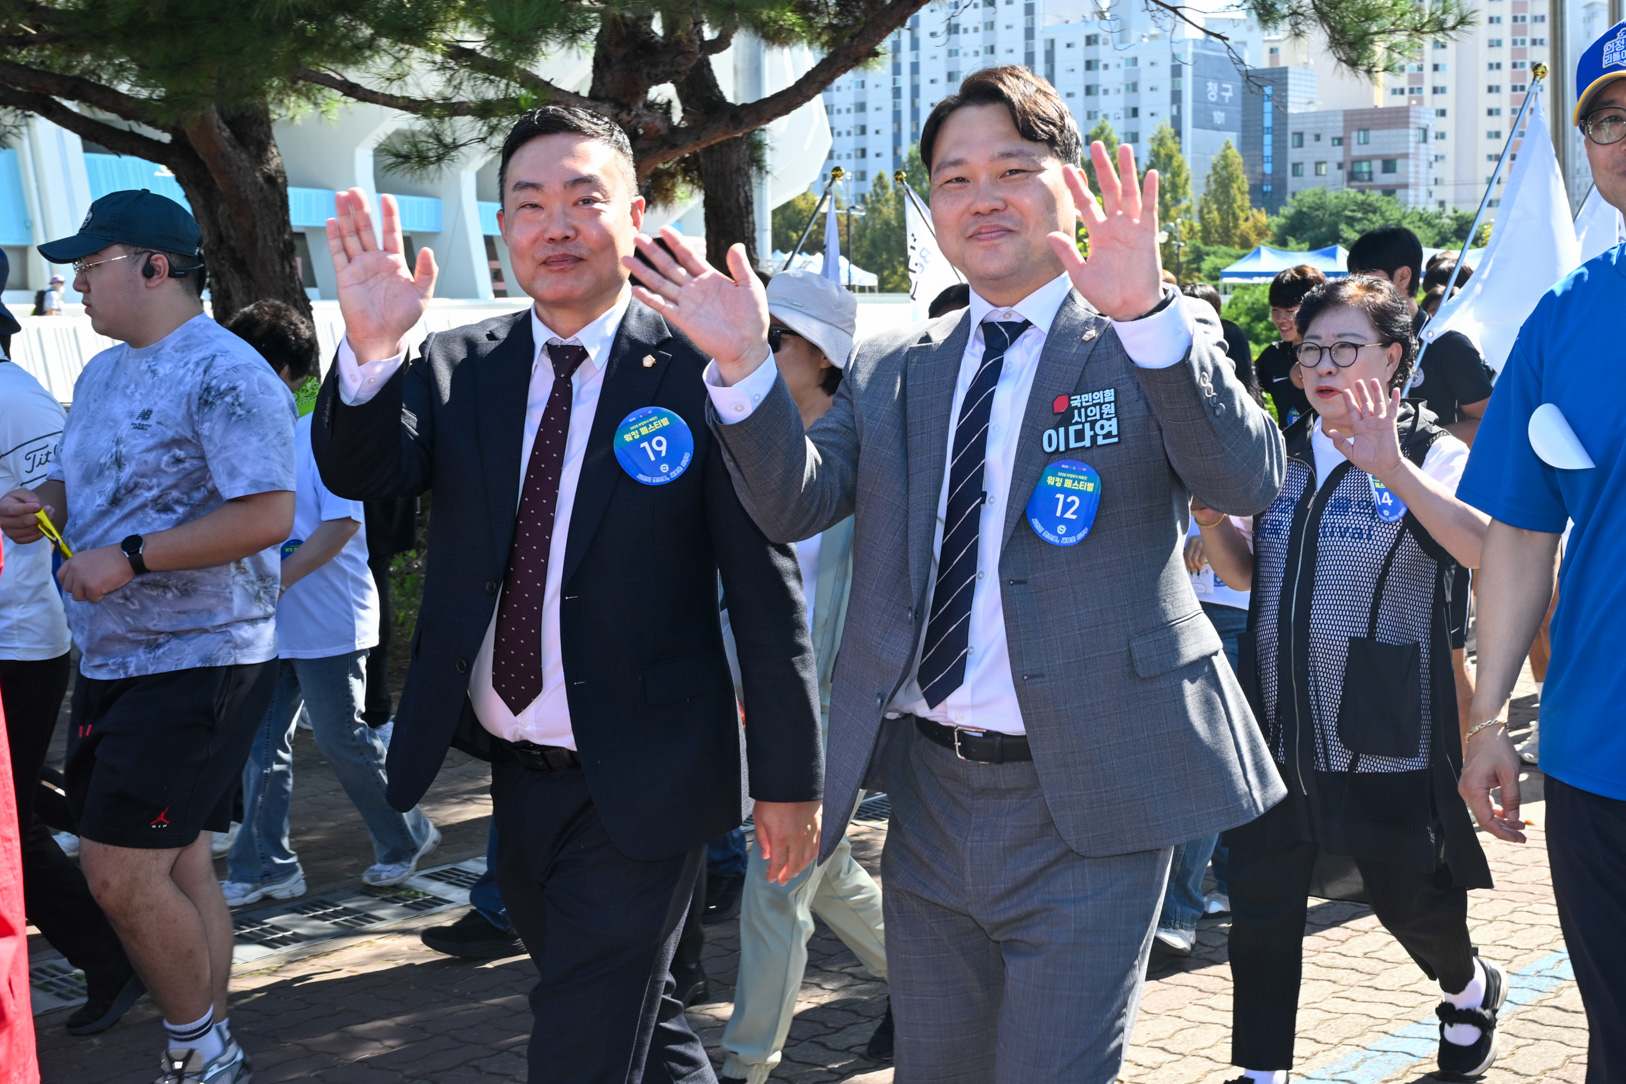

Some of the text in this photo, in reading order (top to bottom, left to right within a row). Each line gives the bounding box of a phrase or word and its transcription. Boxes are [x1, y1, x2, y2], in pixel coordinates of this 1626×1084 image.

[1606, 40, 1626, 55] 의정
[1206, 81, 1233, 103] 청구
[1213, 111, 1225, 125] 101
[1070, 388, 1115, 408] 국민의힘
[1071, 403, 1116, 424] 시의원
[623, 430, 640, 442] 워킹
[639, 417, 670, 436] 페스티벌
[1042, 417, 1119, 453] 이다연
[640, 436, 667, 461] 19
[1046, 475, 1095, 492] 워킹 페스티벌
[1054, 493, 1080, 520] 12
[1374, 491, 1393, 506] 14
